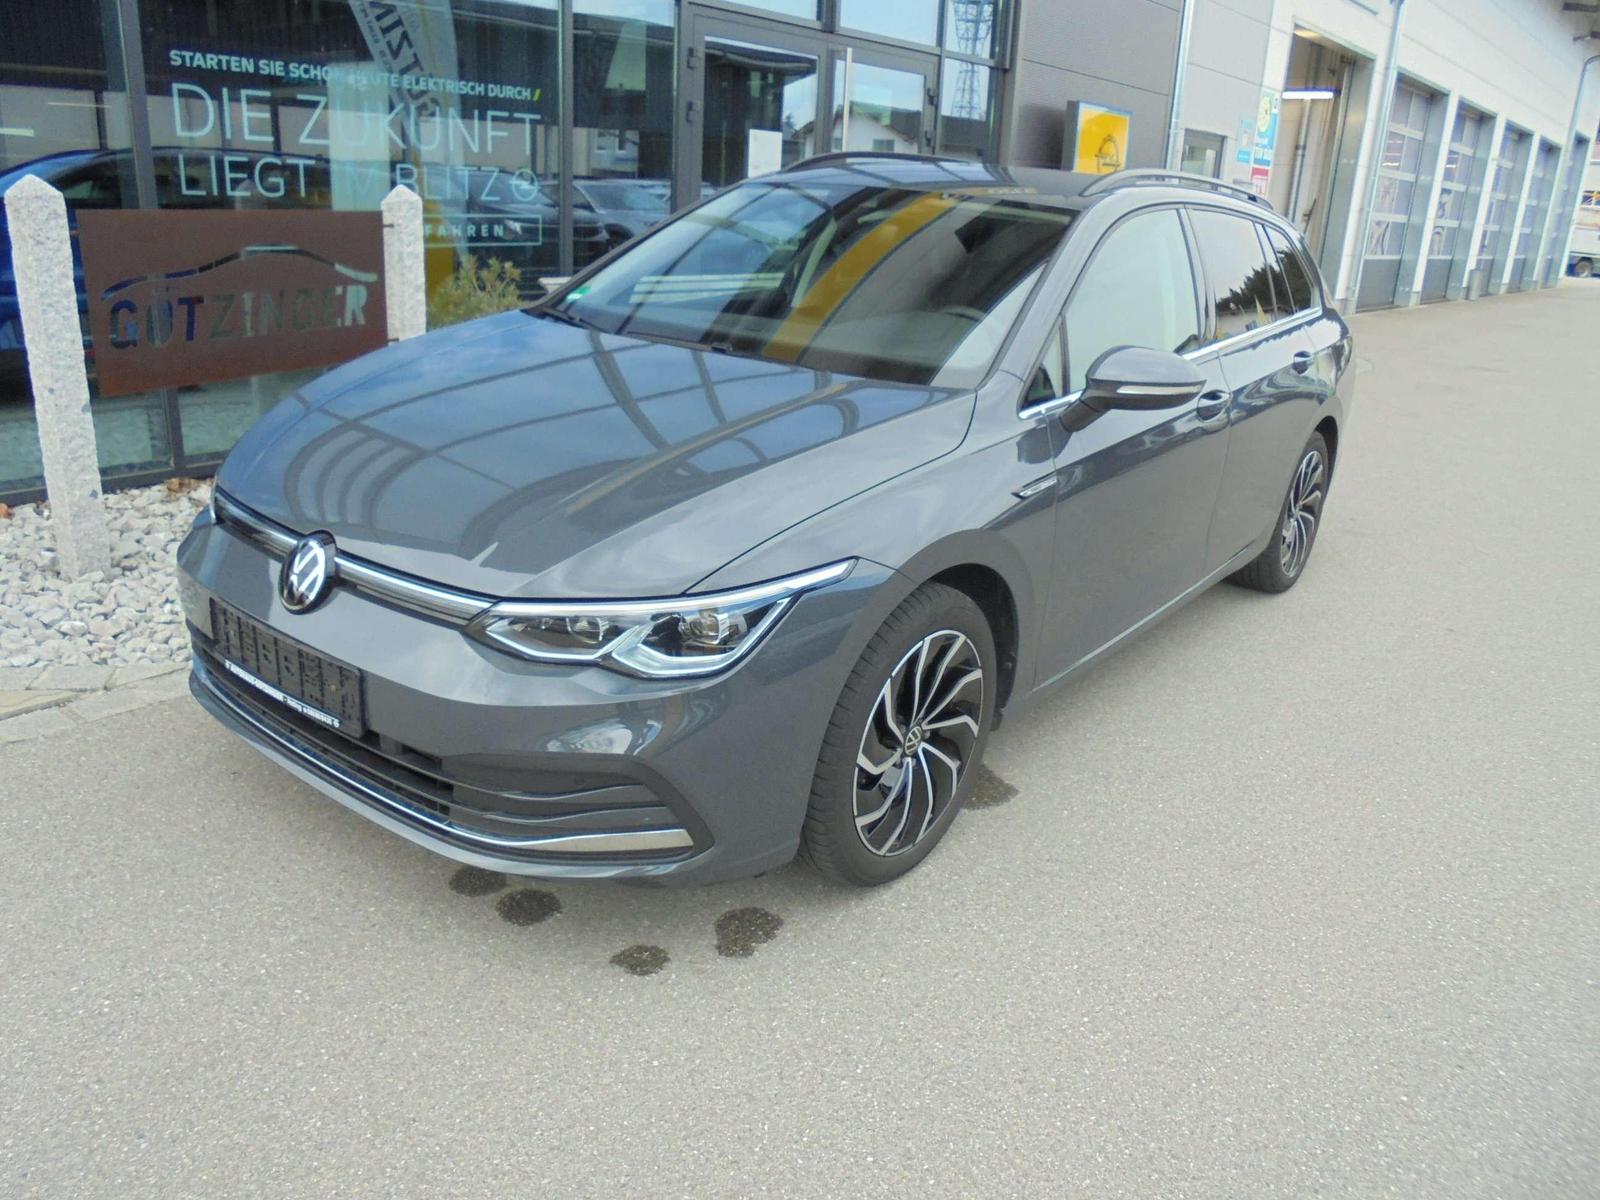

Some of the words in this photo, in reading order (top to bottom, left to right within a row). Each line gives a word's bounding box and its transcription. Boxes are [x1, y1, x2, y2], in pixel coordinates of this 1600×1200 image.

[169, 49, 255, 74] STARTEN
[258, 59, 285, 77] SIE
[289, 62, 345, 82] SCHO
[404, 74, 485, 96] ELEKTRISCH
[488, 83, 531, 101] DURCH
[171, 82, 274, 143] DIE
[296, 94, 541, 156] ZUKUNFT
[178, 153, 316, 198] LIEGT
